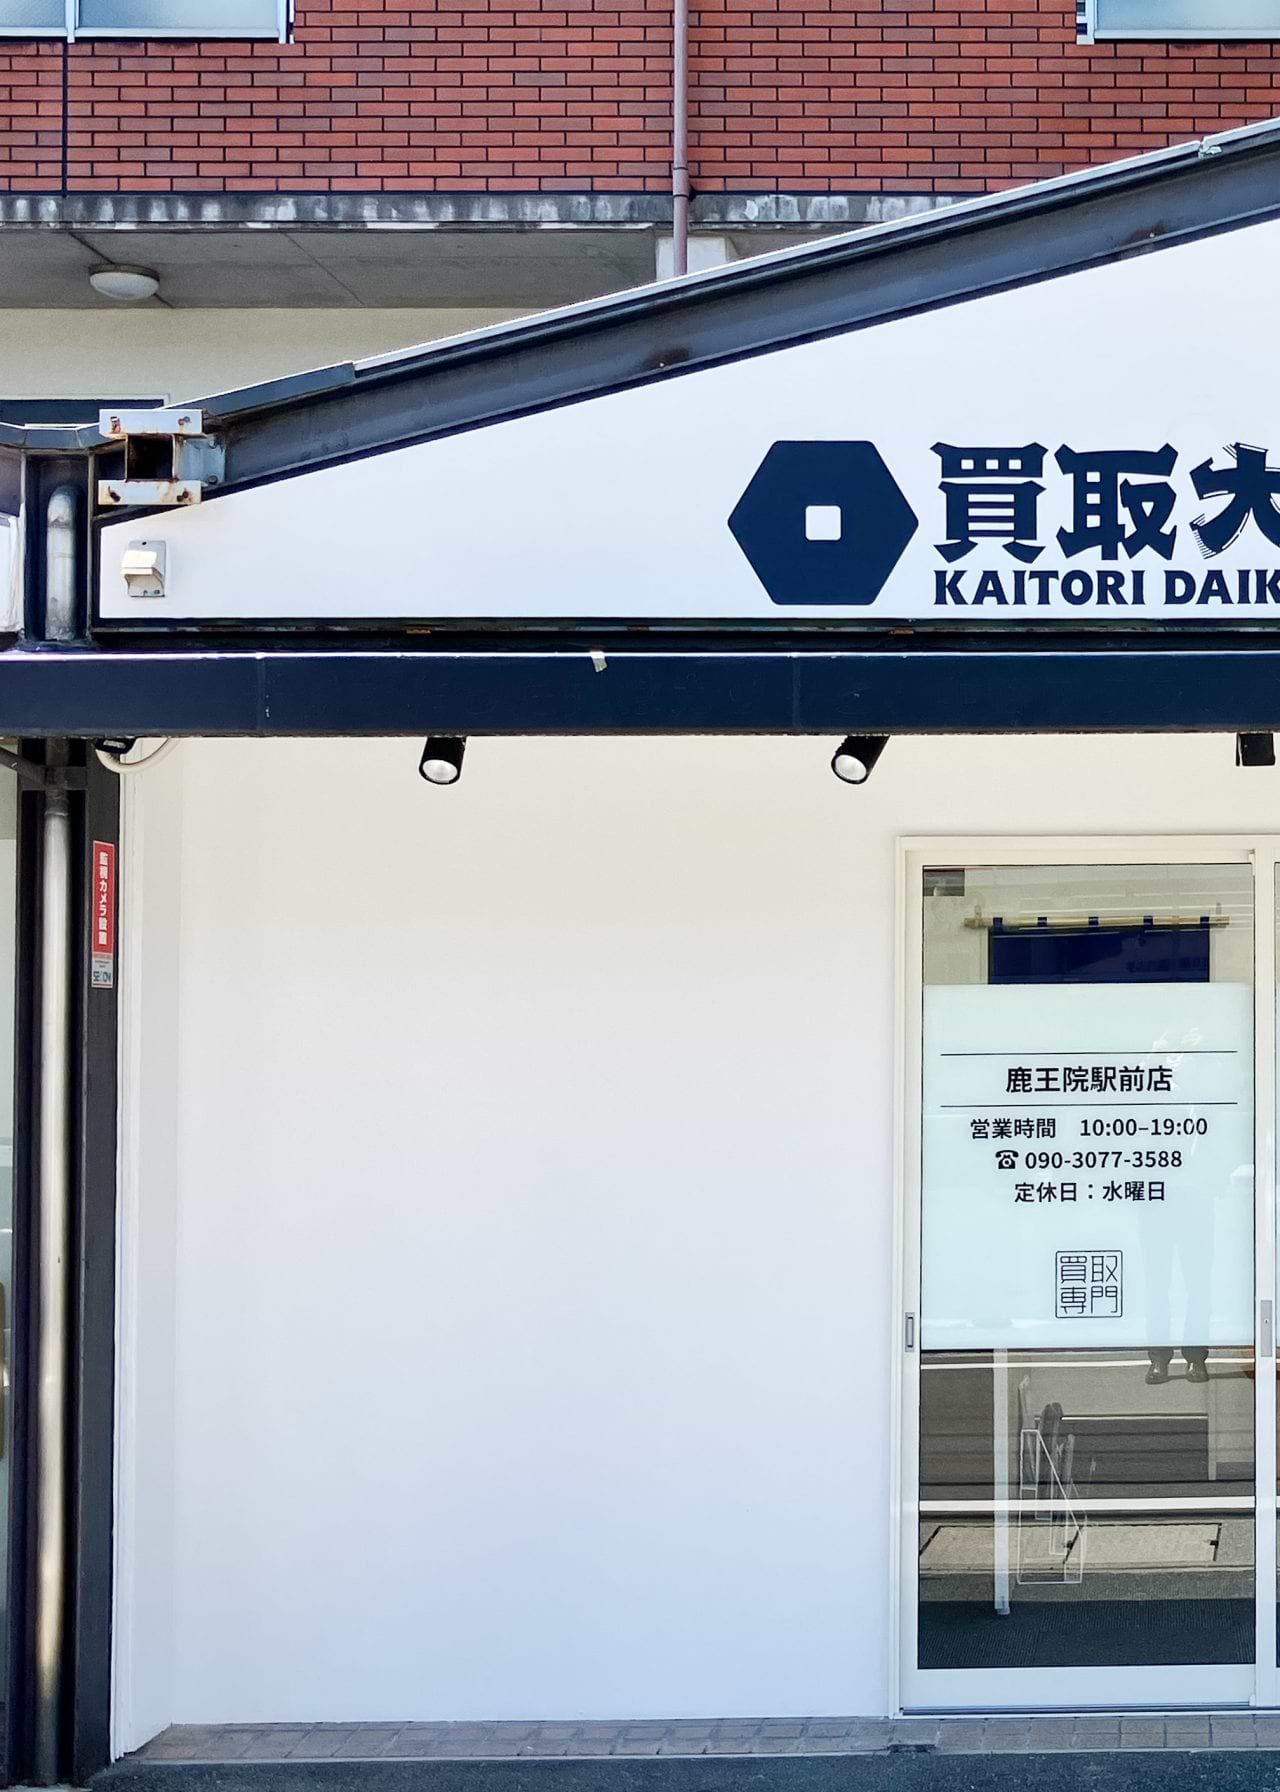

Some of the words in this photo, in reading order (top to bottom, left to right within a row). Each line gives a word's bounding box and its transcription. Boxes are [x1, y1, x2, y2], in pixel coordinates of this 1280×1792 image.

[933, 570, 1145, 605] KAITORI
[1005, 1065, 1174, 1094] 鹿王院駅前店
[970, 1118, 1057, 1140] 営業時間
[1025, 1150, 1183, 1169] 090-3077-3588
